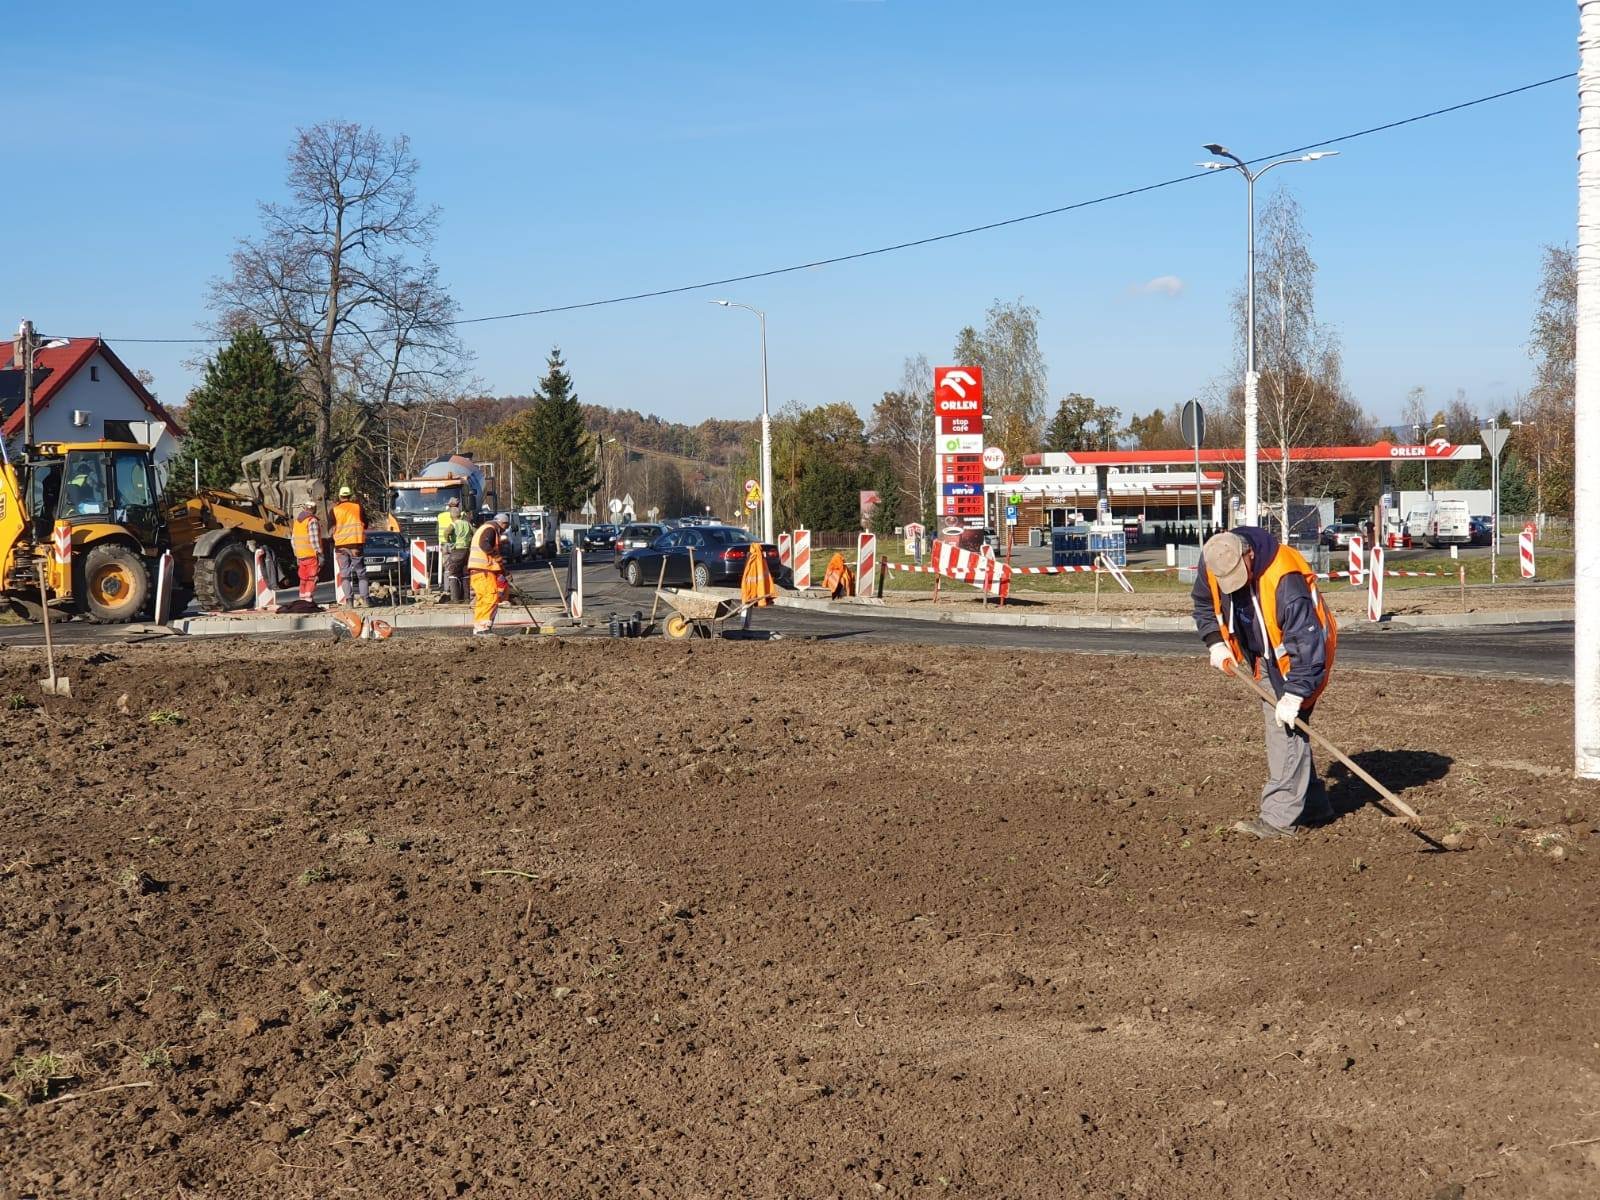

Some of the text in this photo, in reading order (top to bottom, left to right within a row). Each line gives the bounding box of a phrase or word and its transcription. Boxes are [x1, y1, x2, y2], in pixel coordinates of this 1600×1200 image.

[940, 401, 978, 410] ORLEN
[952, 418, 969, 426] stop
[1390, 447, 1426, 456] ORLEN
